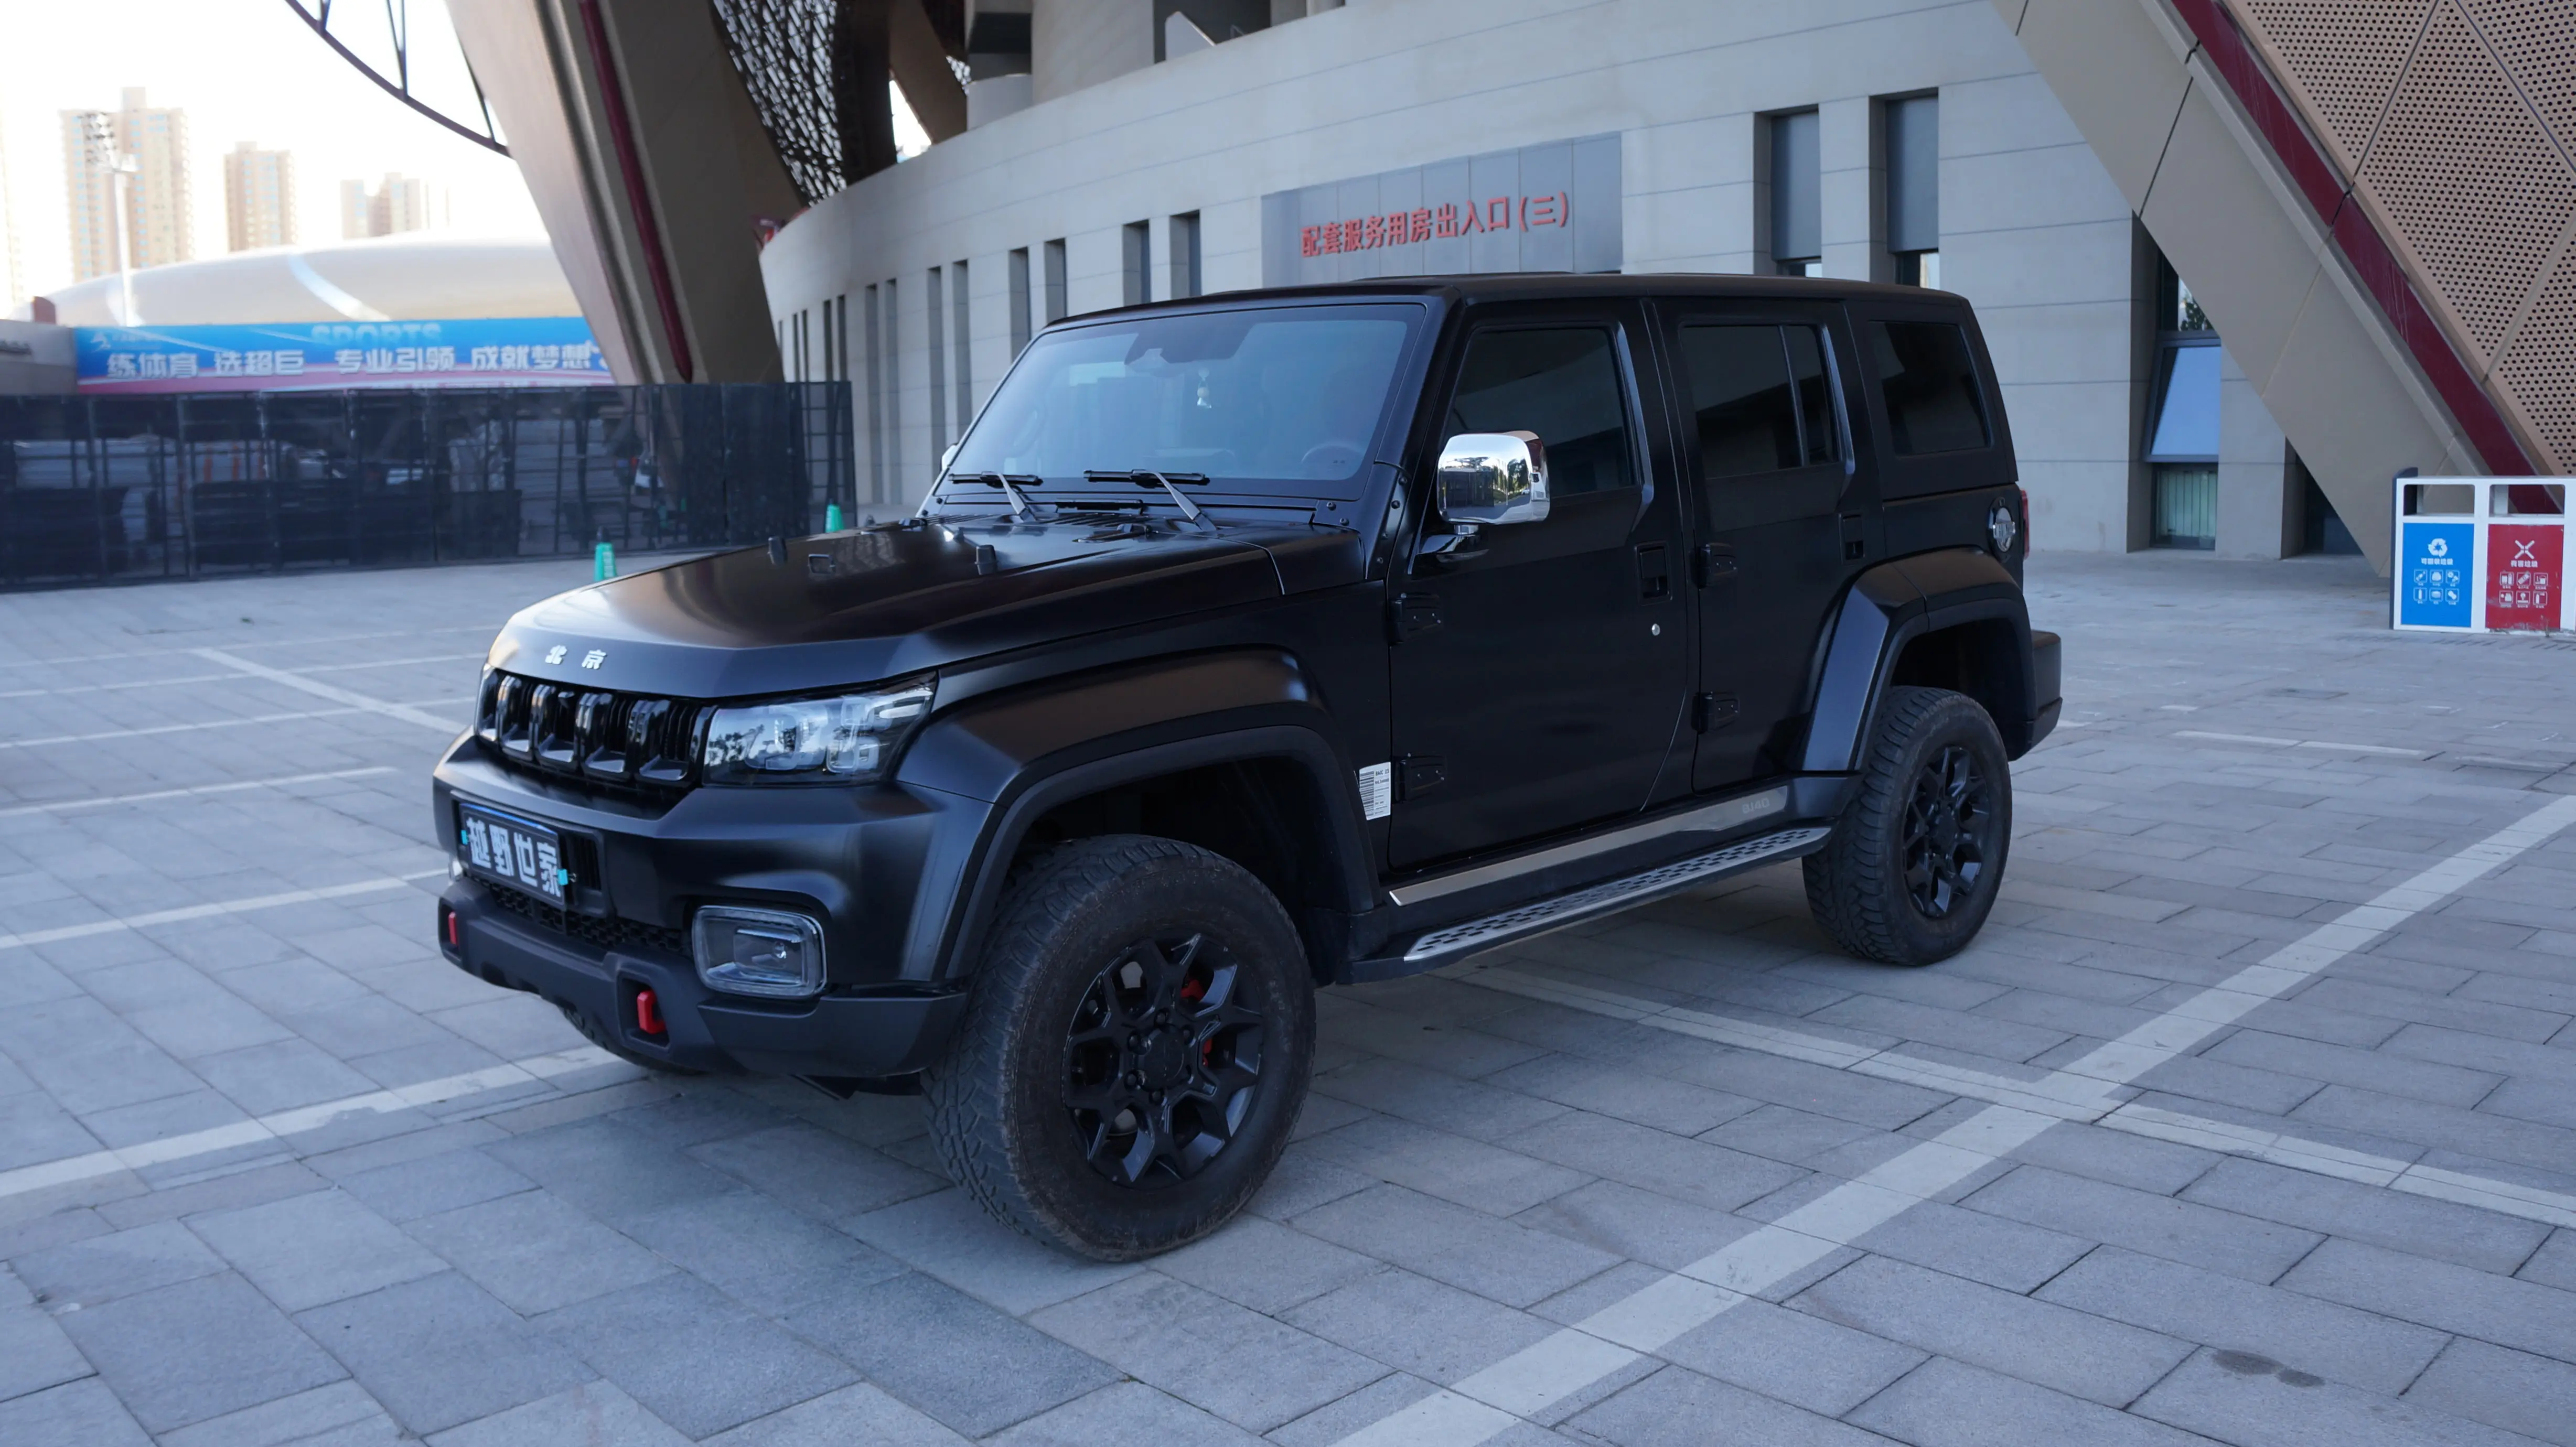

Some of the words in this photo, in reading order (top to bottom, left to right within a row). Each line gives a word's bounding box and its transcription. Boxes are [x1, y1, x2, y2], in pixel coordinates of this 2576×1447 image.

[1301, 191, 1570, 258] 配套服务用房出入口(三)
[106, 352, 198, 379] 练体育
[335, 346, 456, 374] 专业引领
[470, 344, 592, 371] 成就梦想
[545, 644, 607, 669] 北京
[466, 816, 562, 898] 越野世家
